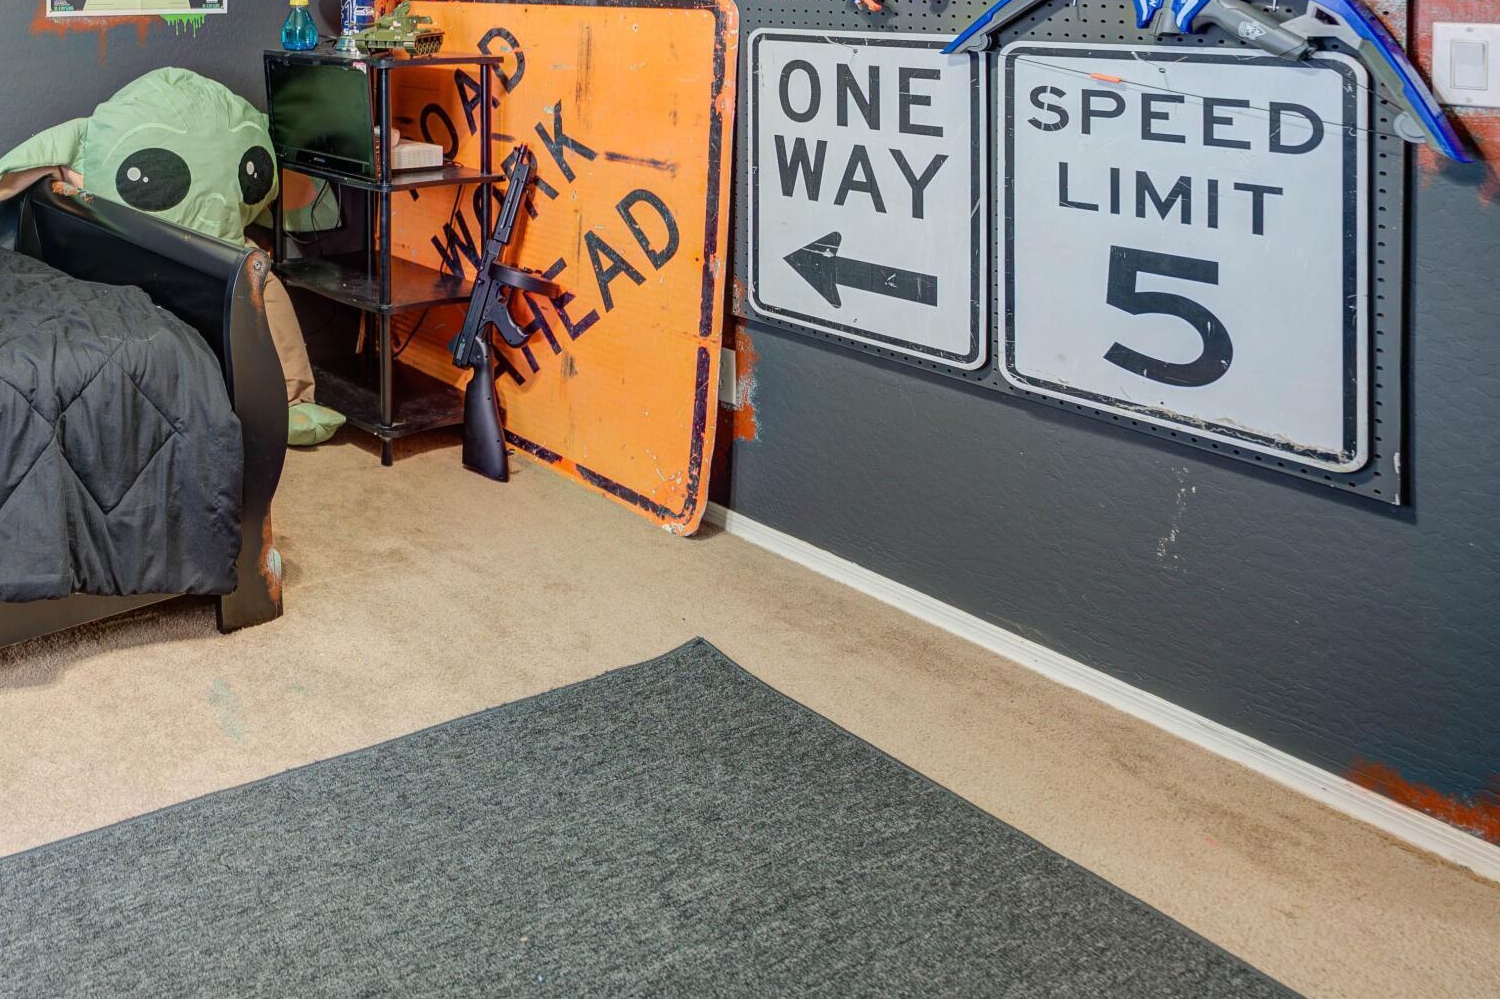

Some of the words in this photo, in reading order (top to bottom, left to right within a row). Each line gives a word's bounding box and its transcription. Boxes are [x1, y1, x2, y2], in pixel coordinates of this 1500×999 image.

[407, 27, 526, 202] OAD
[778, 59, 944, 138] ONE
[1027, 85, 1325, 155] SPEED
[774, 135, 949, 220] WAY
[1058, 161, 1284, 236] LIMIT
[1102, 244, 1234, 388] 5
